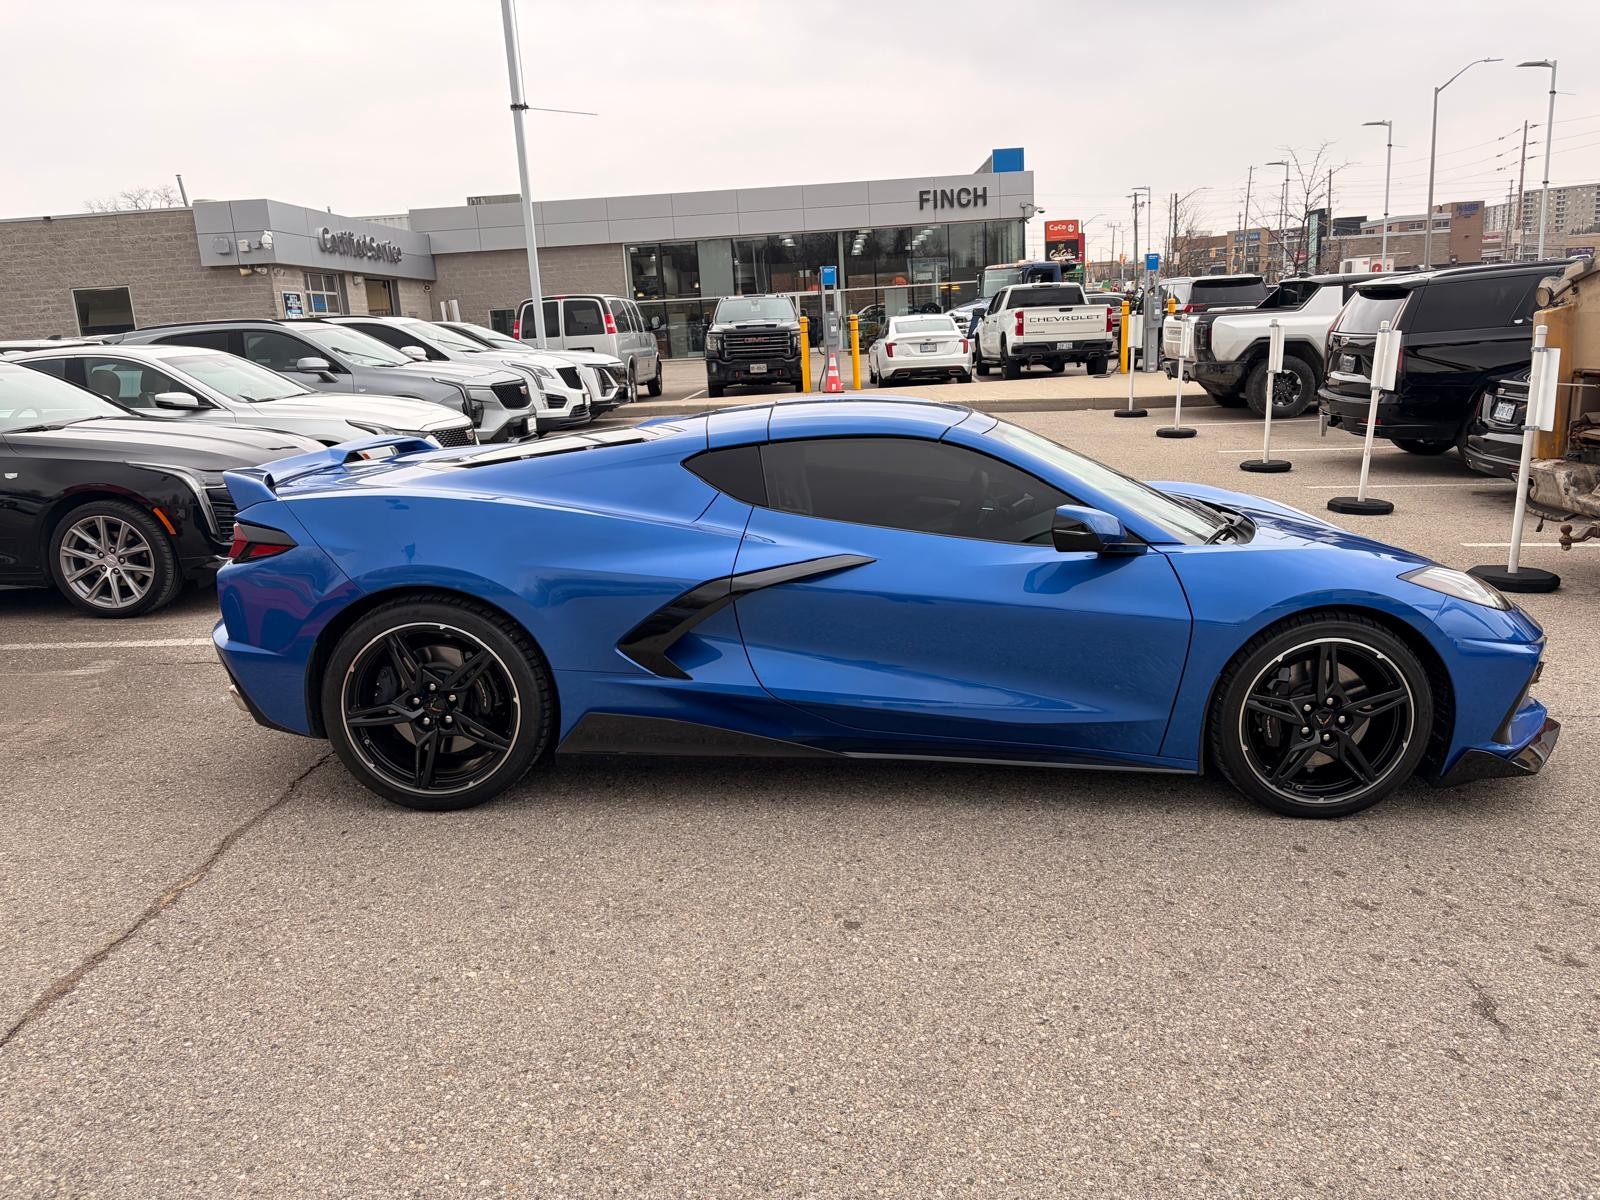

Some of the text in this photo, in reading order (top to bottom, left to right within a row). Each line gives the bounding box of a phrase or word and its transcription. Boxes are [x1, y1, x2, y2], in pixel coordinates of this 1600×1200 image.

[918, 186, 988, 210] FINCH
[1029, 314, 1102, 323] CHEVROLET
[743, 336, 770, 344] GMC
